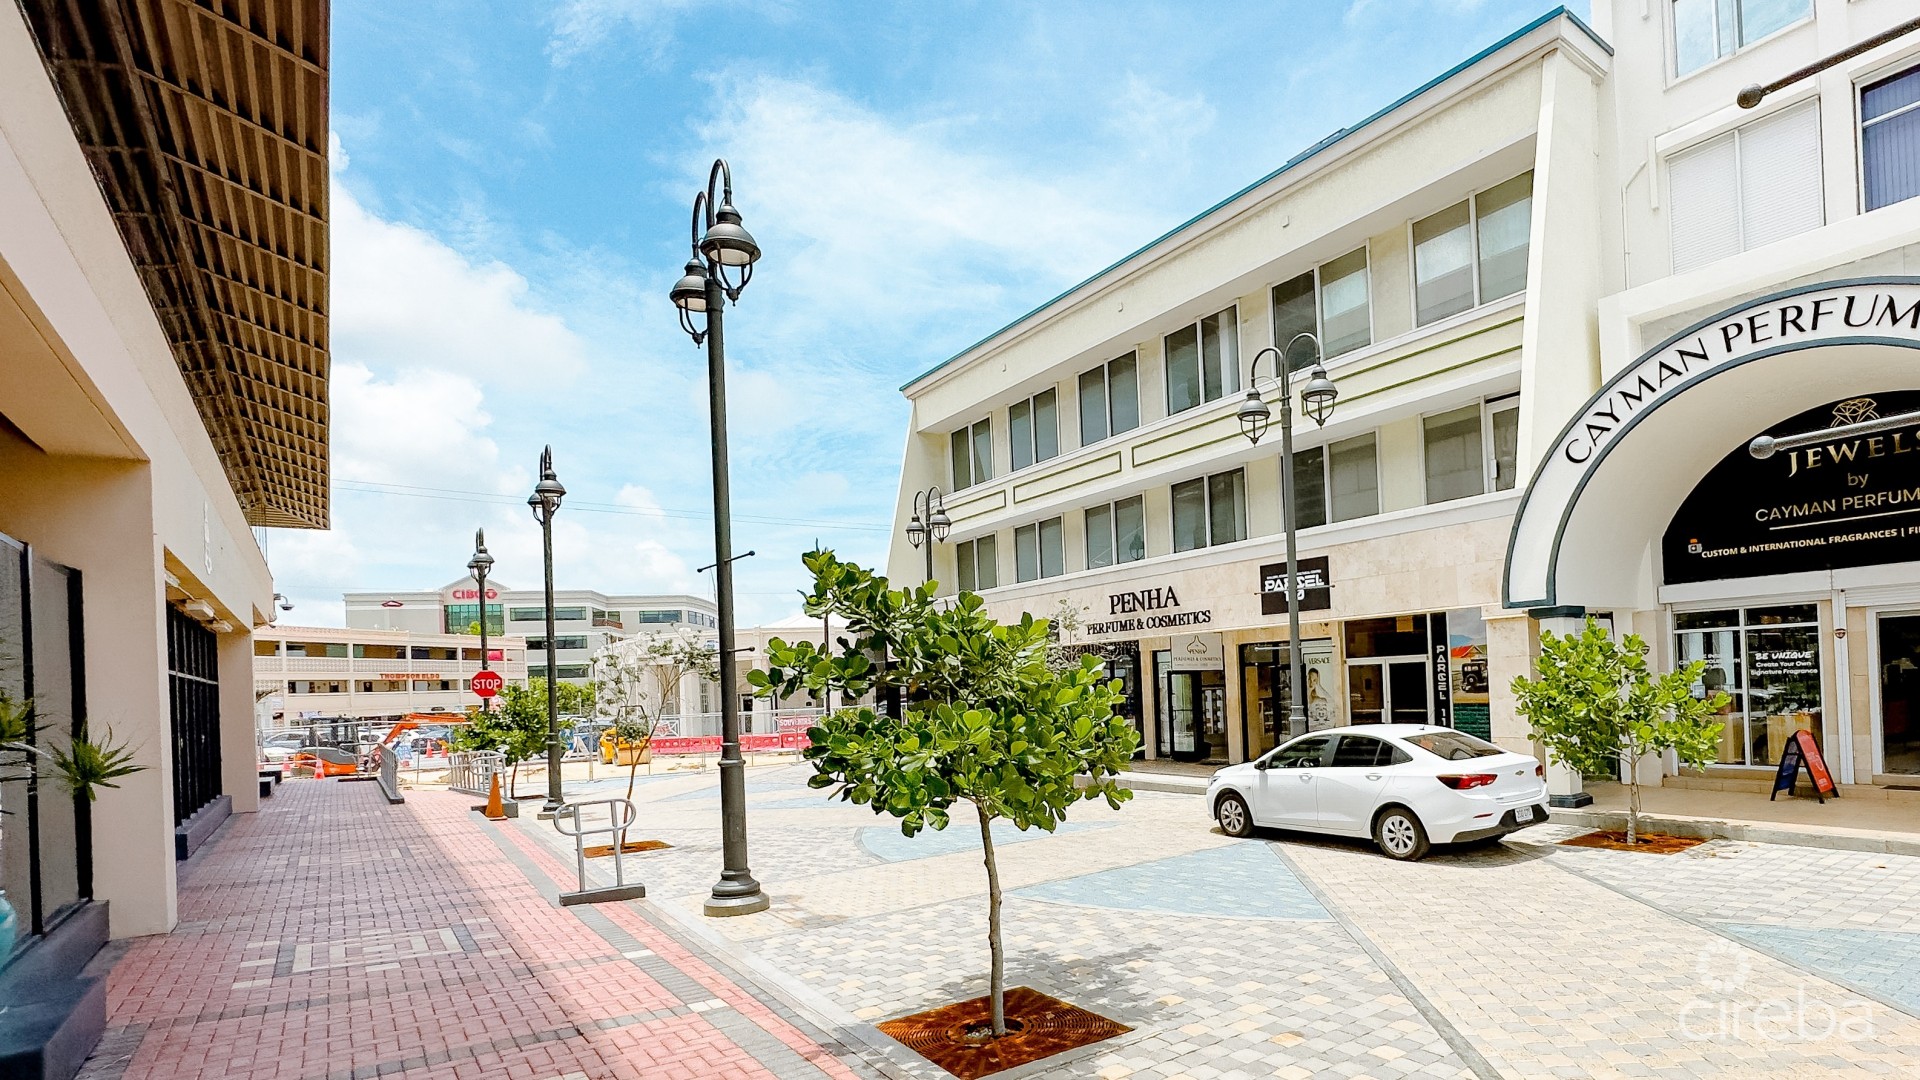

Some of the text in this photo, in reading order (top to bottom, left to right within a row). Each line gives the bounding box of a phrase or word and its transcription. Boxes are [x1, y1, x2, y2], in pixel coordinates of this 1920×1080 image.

[1565, 337, 1710, 464] CAYMAN
[1847, 472, 1869, 488] by
[1755, 487, 1920, 522] CAYMAN PERFUM
[1701, 547, 1739, 558] CUSTOM
[1740, 546, 1748, 554] &
[1749, 537, 1827, 553] INTERNATIONAL
[1828, 528, 1898, 544] FRAGRANCES
[1908, 525, 1920, 535] FI
[1109, 585, 1180, 615] PENHA
[1087, 610, 1212, 635] PERFUME & COSMETICS
[1308, 657, 1330, 665] VERSACE
[1771, 651, 1812, 660] UNIQUE
[473, 679, 501, 689] STOP
[1436, 645, 1447, 700] PARCEL
